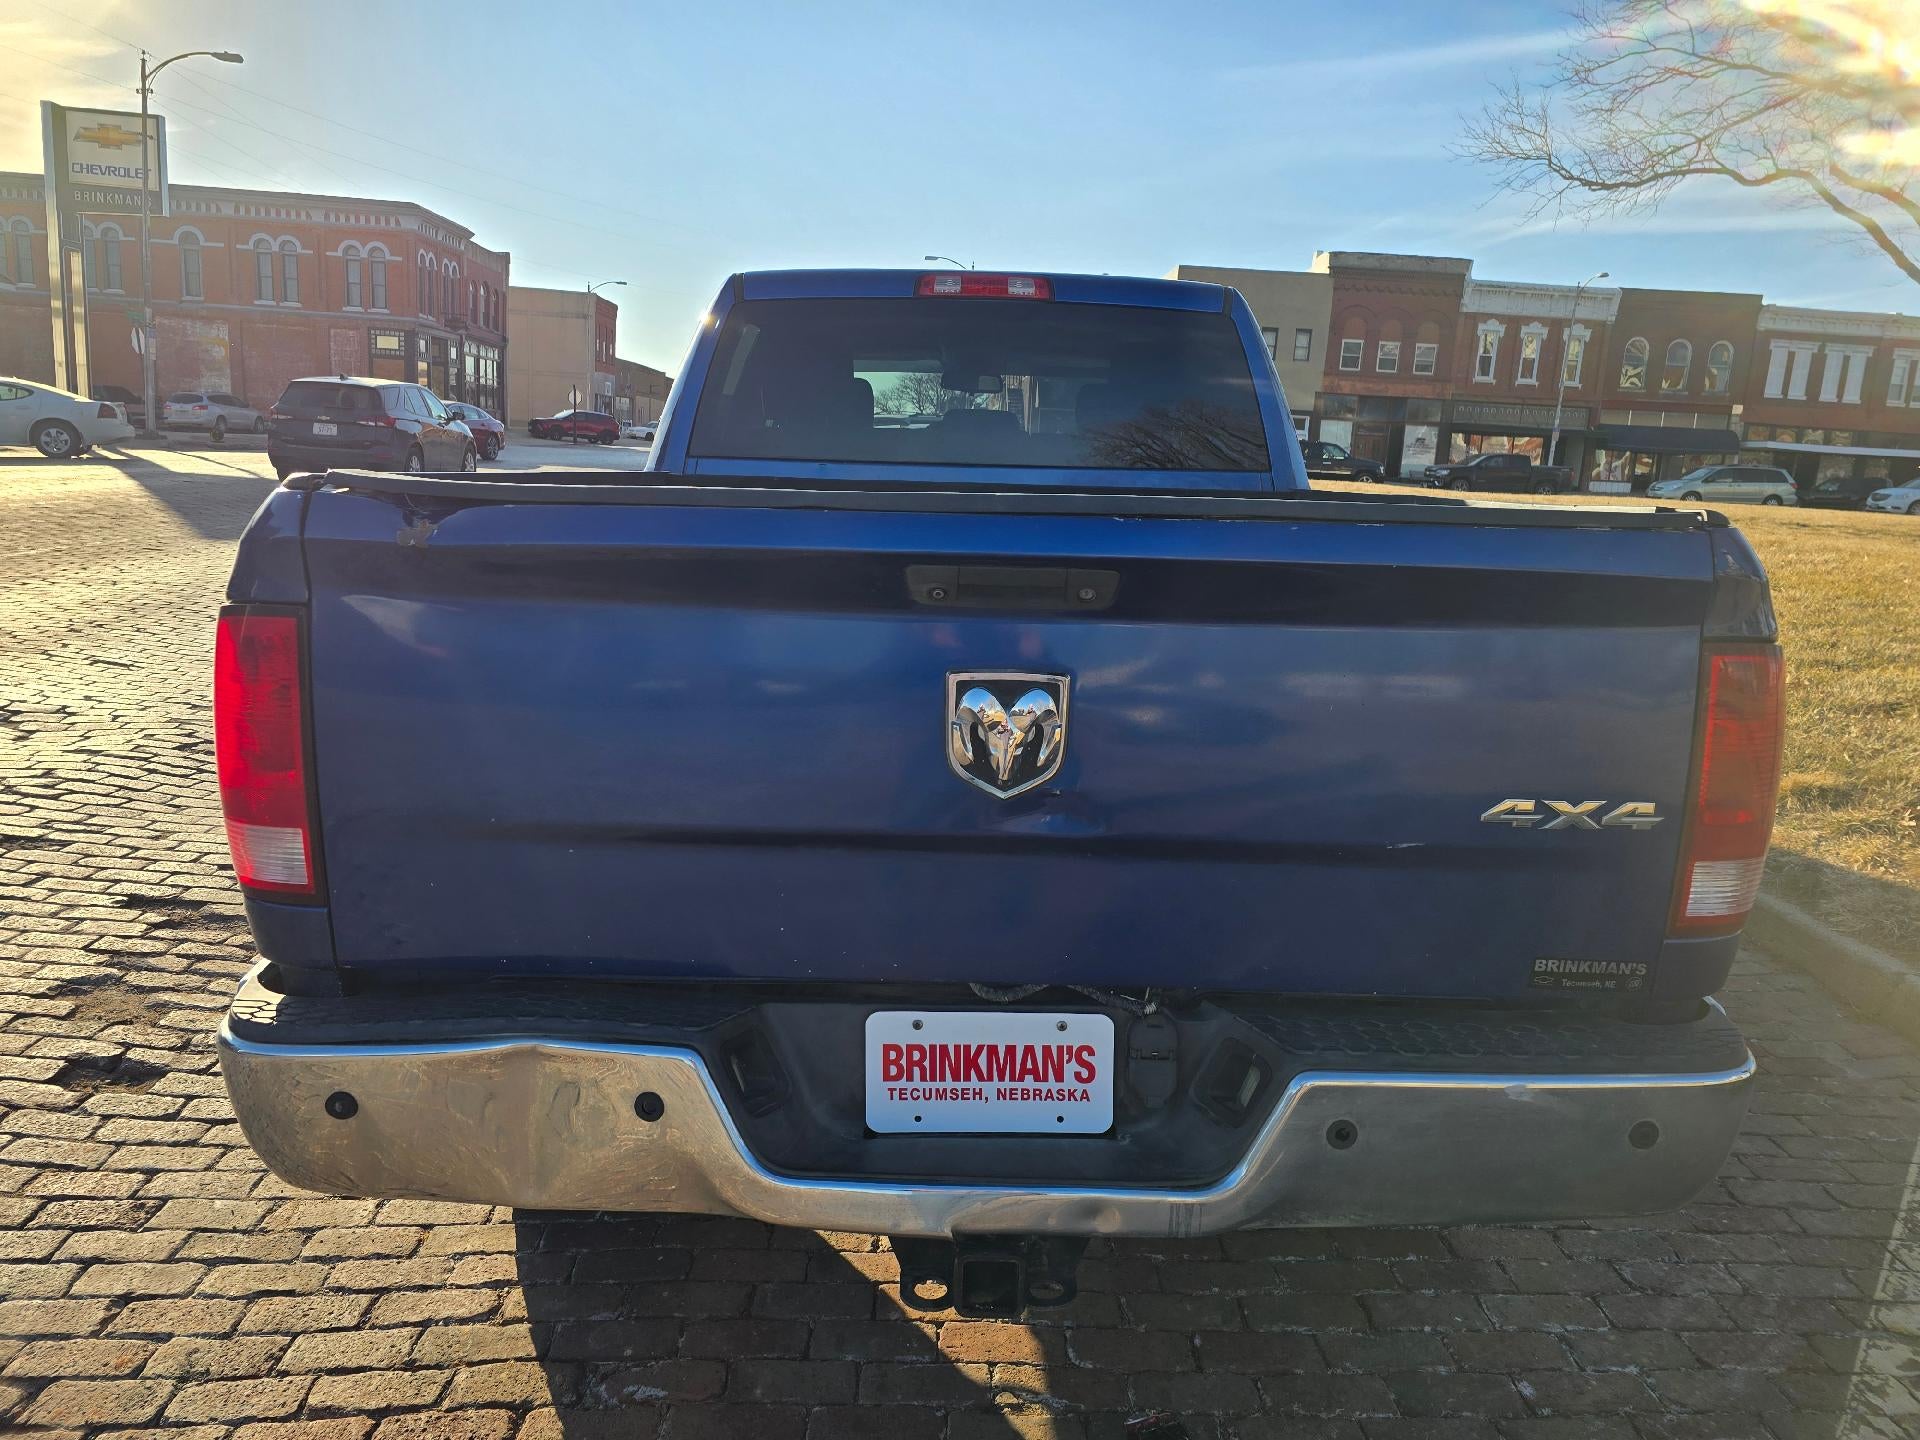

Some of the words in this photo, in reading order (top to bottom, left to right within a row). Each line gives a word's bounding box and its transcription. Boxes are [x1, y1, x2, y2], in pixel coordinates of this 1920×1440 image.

[71, 162, 152, 179] CHEVROLE
[1480, 798, 1665, 830] 4X4
[1534, 959, 1648, 976] BRINKMAN'S
[882, 1043, 1097, 1085] BRINKMAN'S
[888, 1087, 989, 1104] TECUMSEH,
[996, 1087, 1091, 1102] NEBRASKA
